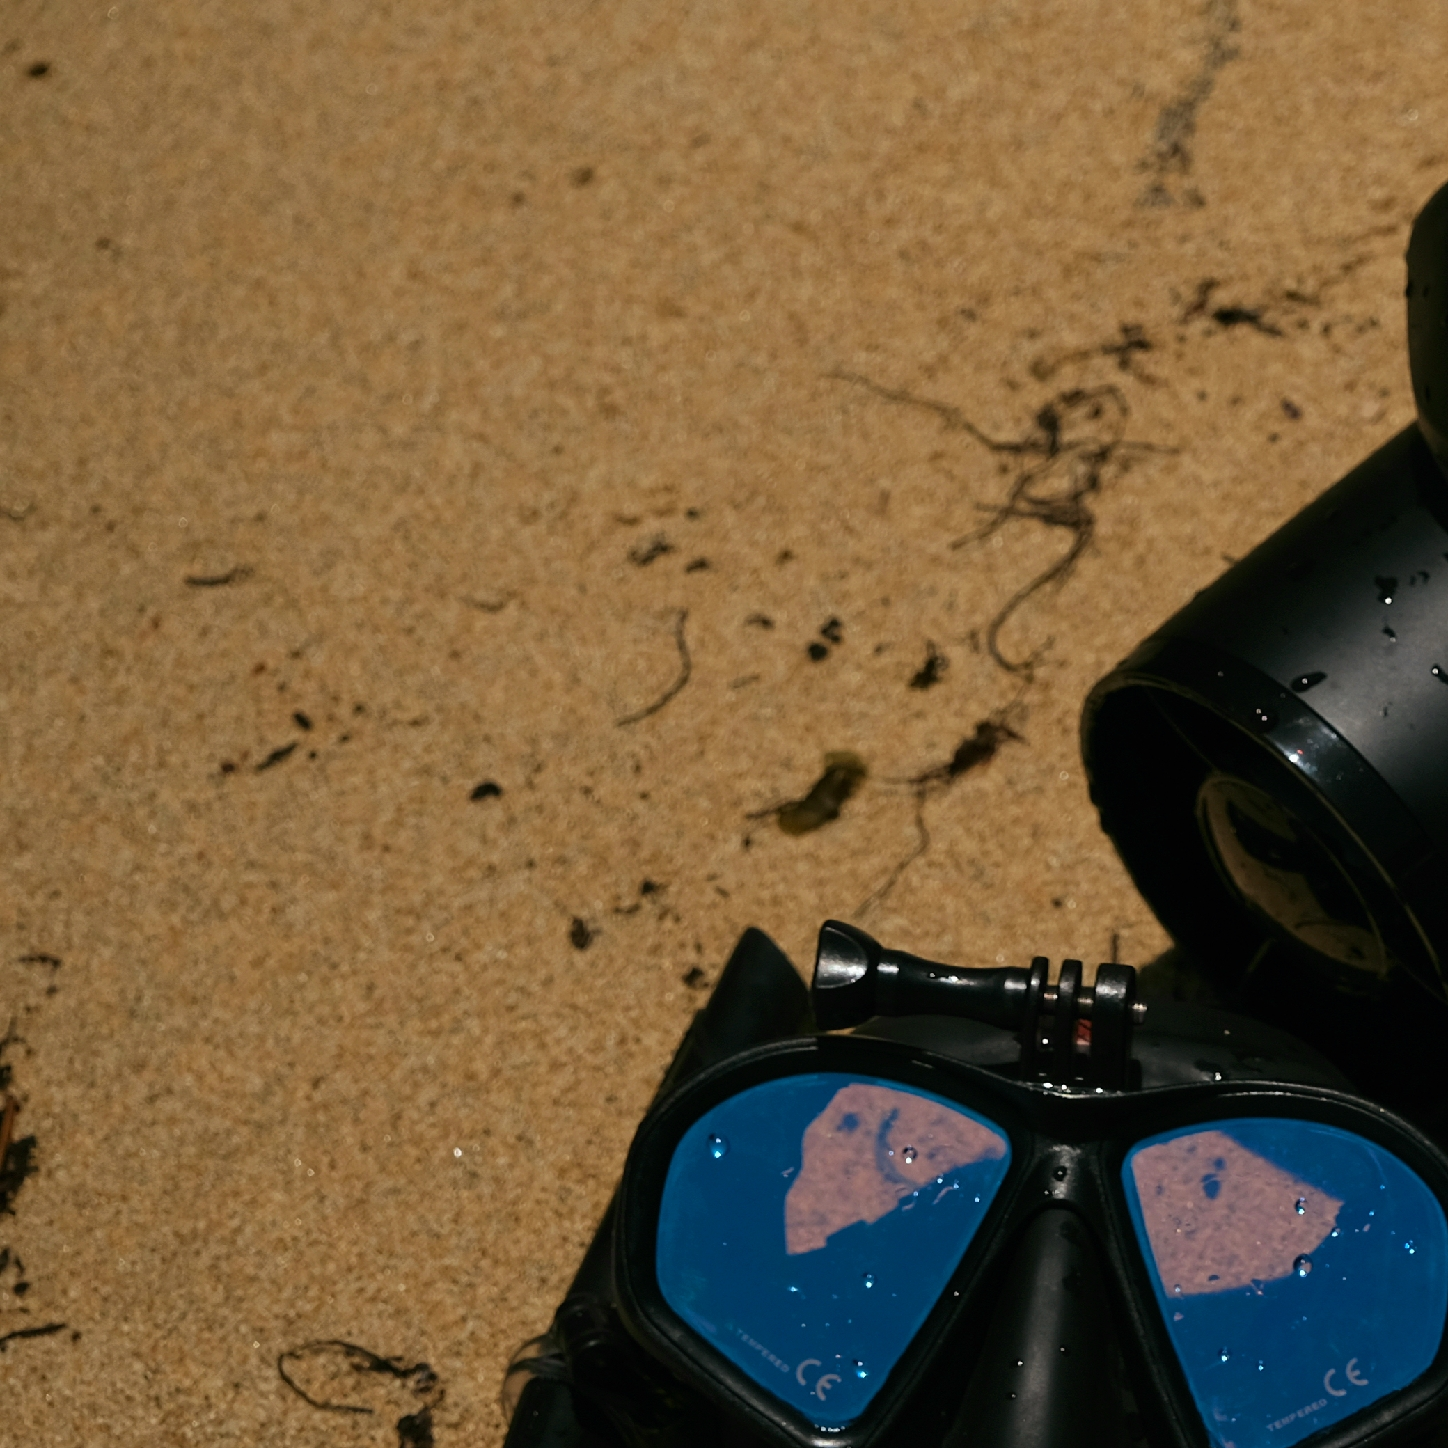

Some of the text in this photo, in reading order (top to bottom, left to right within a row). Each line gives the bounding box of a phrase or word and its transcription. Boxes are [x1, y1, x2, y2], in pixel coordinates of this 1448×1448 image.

[736, 1327, 843, 1402] TEMPERED CE
[1265, 1356, 1370, 1433] TEMPERED CE
